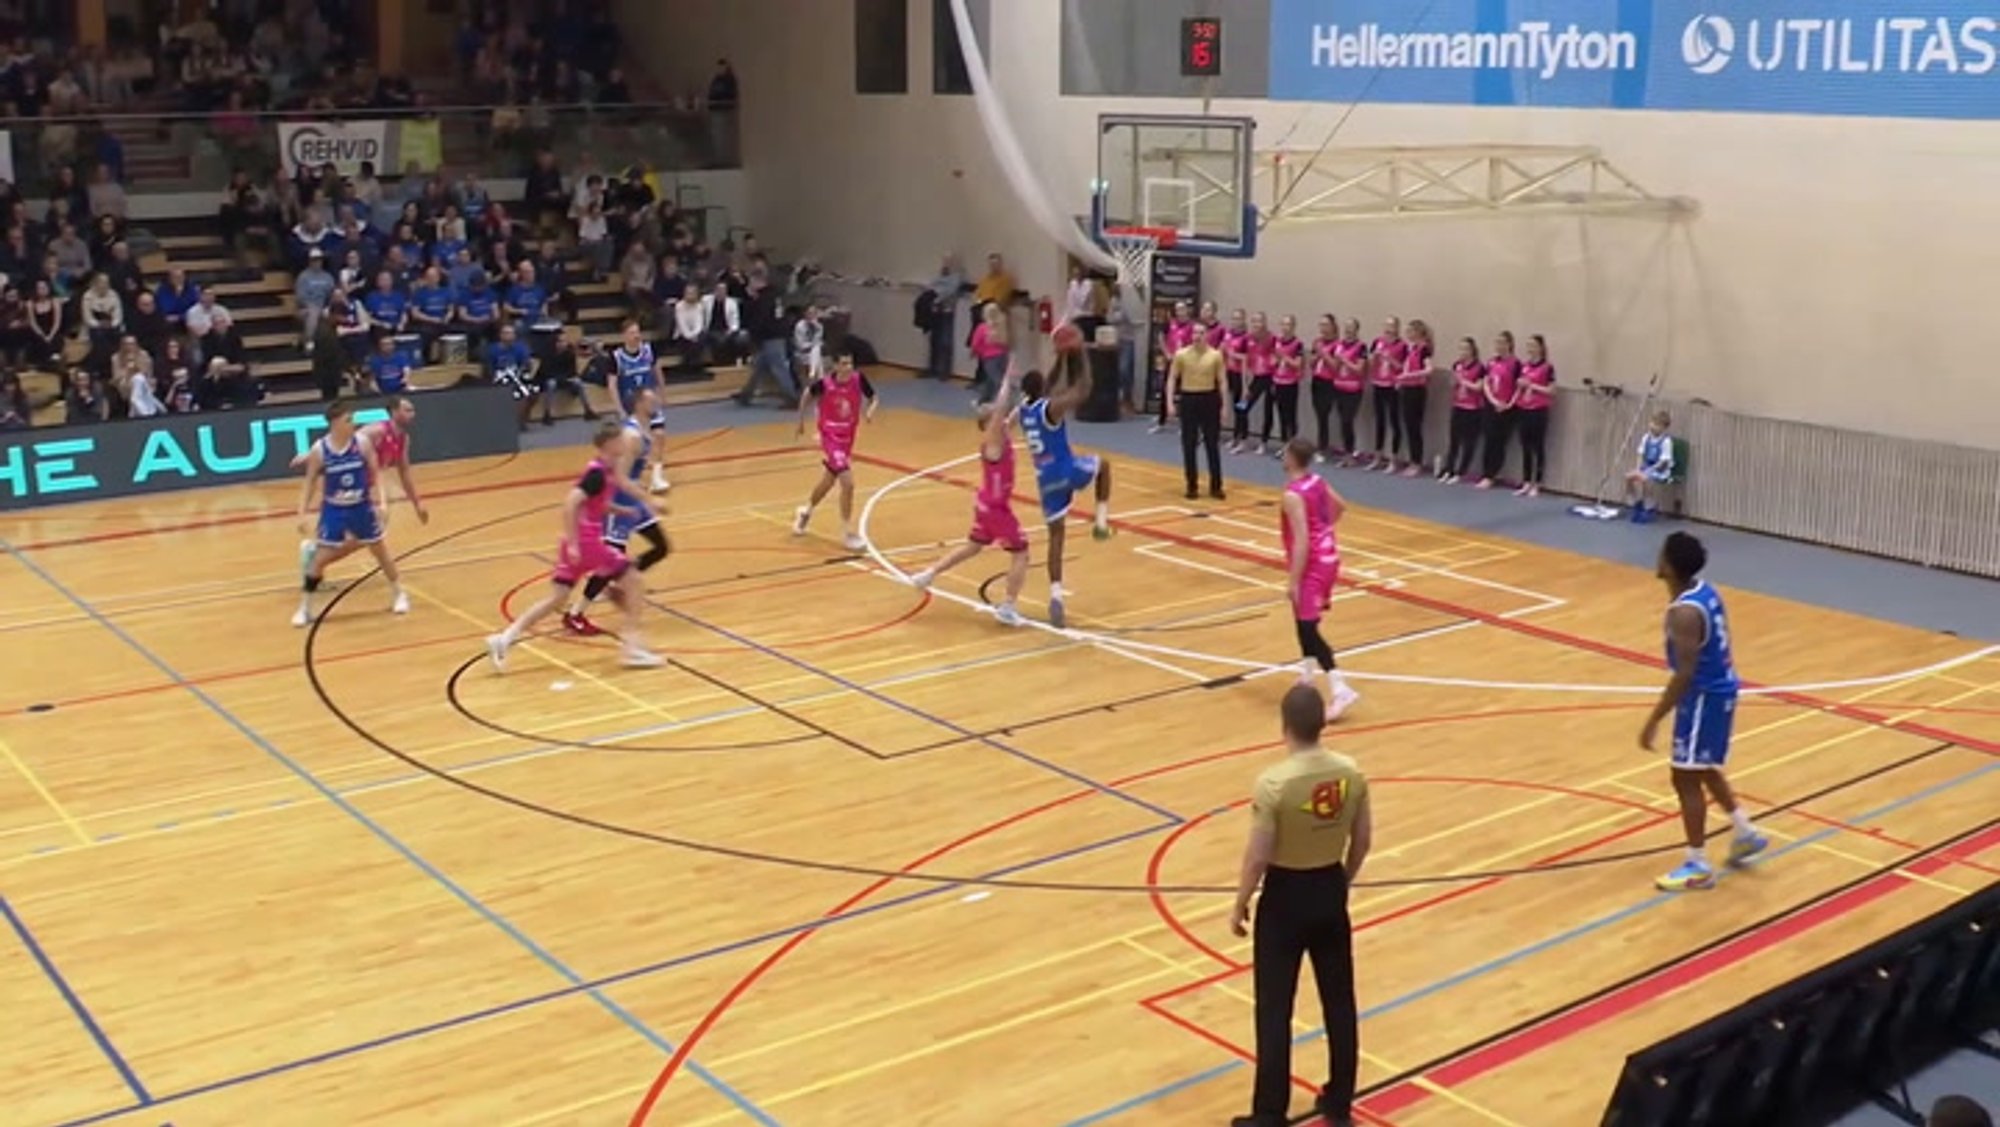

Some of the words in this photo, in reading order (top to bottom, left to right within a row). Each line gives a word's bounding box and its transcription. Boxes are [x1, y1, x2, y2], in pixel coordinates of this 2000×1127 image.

[1312, 22, 1636, 79] HellermannTyton
[1747, 17, 1998, 73] UTILITAS
[301, 138, 379, 161] REHVID
[133, 408, 391, 483] AUT
